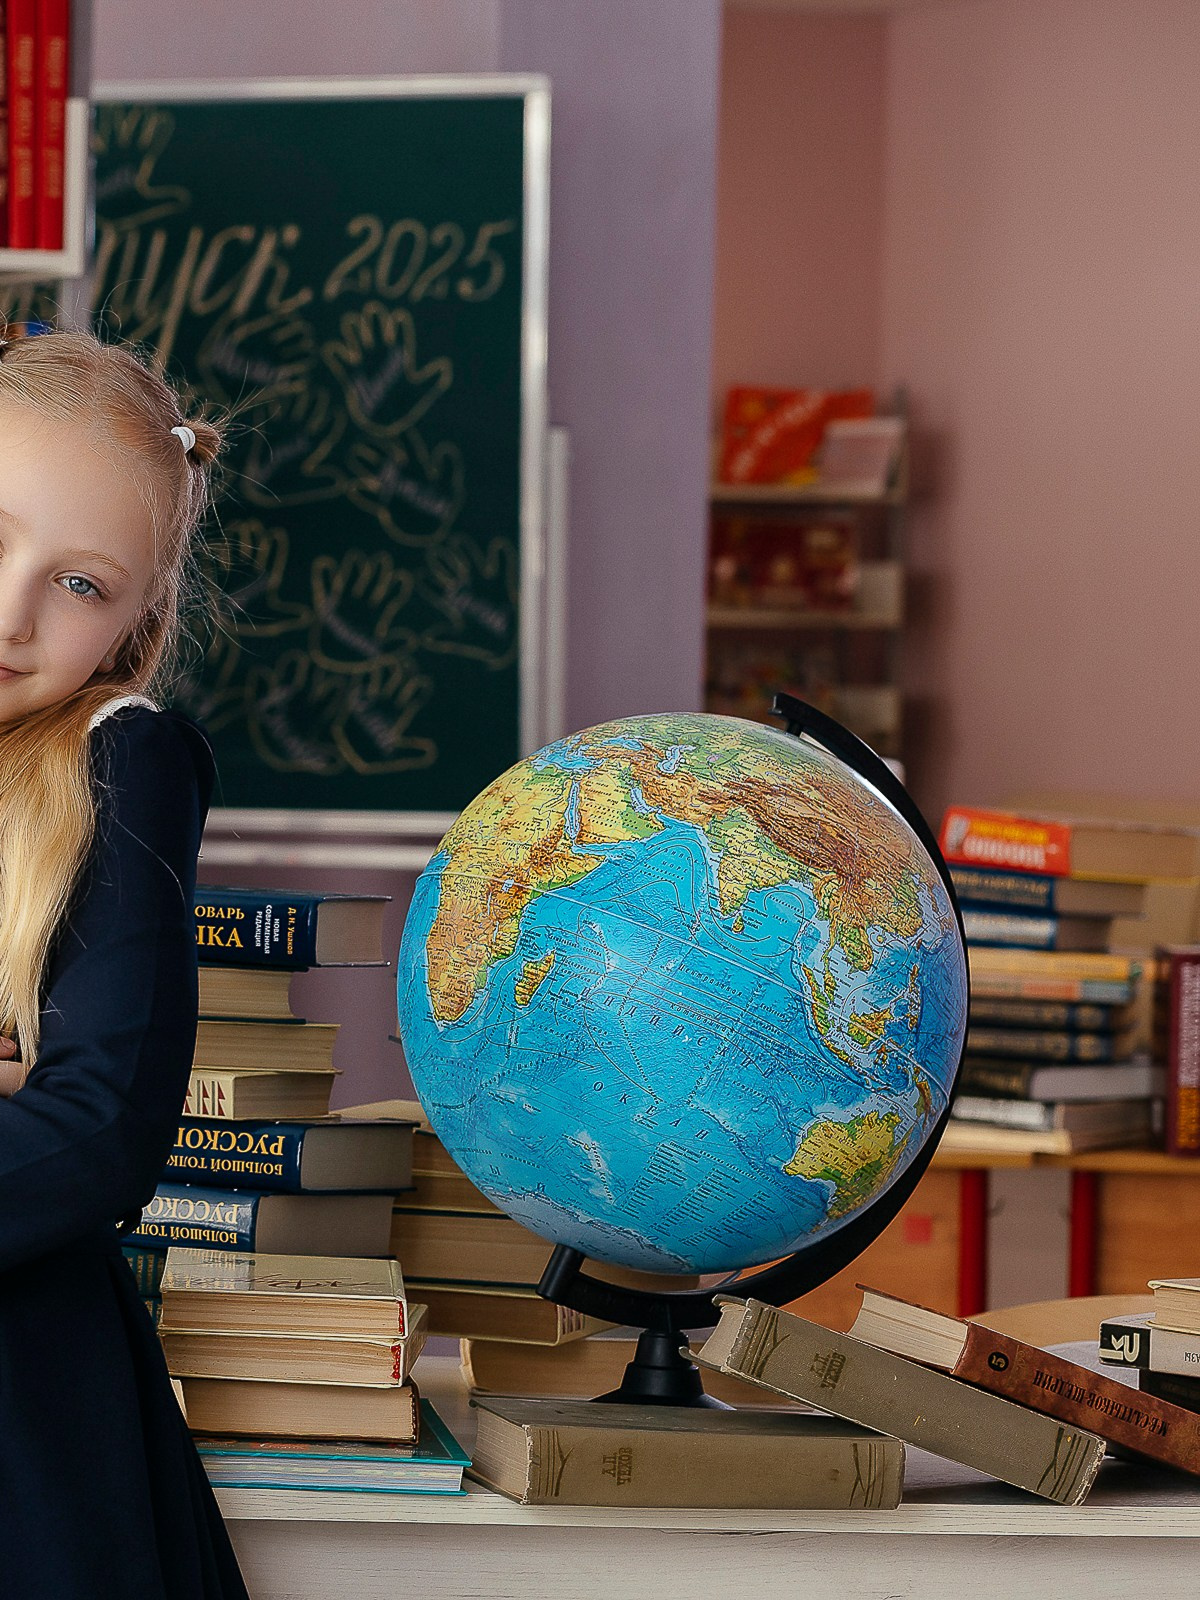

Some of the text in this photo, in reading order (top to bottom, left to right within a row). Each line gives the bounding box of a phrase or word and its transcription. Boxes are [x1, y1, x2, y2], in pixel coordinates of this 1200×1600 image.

[323, 213, 516, 302] 2025
[194, 905, 245, 920] ОВАРЬ
[254, 911, 263, 947] РЕДАКЦИЯ
[264, 904, 273, 954] СОВРЕМЕННАЯ
[581, 987, 774, 1078] ИНДИЙСКИЙ
[593, 1081, 706, 1140] ОКЕАН
[173, 1127, 286, 1156] РУССКОГ
[167, 1154, 283, 1176] БОЛЬШОЙ ТОЛК
[146, 1196, 239, 1225] РУССКО
[169, 1226, 238, 1244] БОЛЬШОЙ
[990, 1355, 1007, 1369] 5
[616, 1447, 633, 1487] ЧЕХОВ
